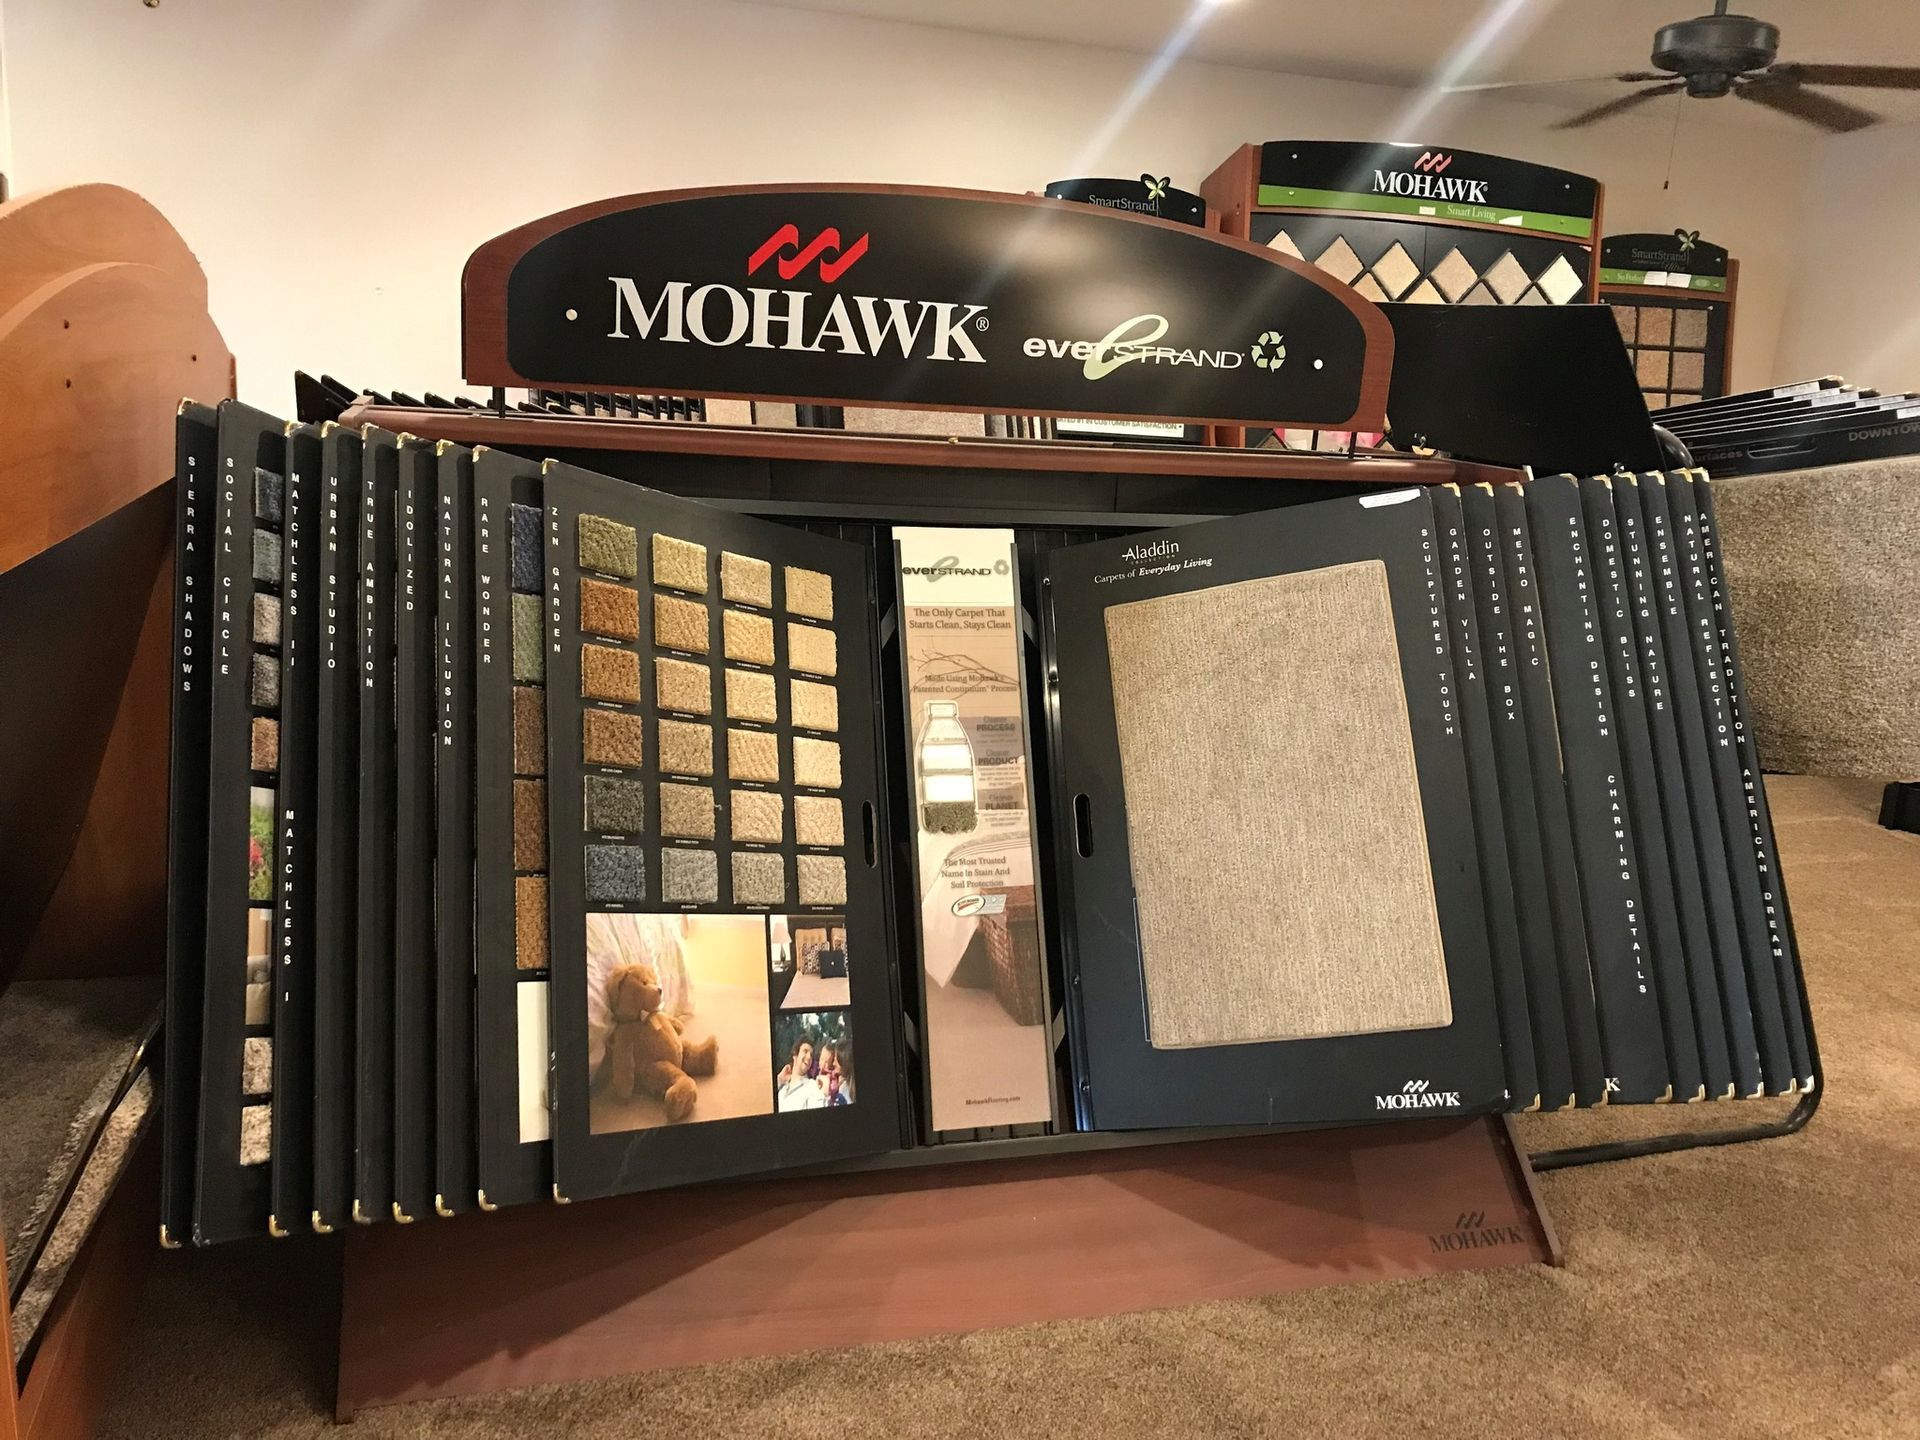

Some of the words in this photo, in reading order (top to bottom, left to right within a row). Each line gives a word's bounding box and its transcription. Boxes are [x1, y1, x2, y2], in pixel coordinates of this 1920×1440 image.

[1089, 194, 1157, 212] SmartStrand
[1372, 169, 1488, 203] MOHAWK
[1447, 205, 1471, 217] Smart
[1472, 207, 1496, 222] Living
[185, 456, 196, 551] SIERRA
[225, 457, 234, 553] SOCIAL
[290, 472, 300, 616] MATCHLESS
[329, 476, 338, 552] URBAN
[366, 481, 374, 539] TRUE
[406, 490, 414, 611] IDOLIZED
[444, 495, 452, 600] NATURAL
[481, 497, 489, 554] RARE
[551, 507, 559, 546] ZEN
[1094, 571, 1126, 584] Carpets
[1127, 569, 1137, 579] of
[1139, 562, 1181, 577] Everyday
[1183, 557, 1213, 569] Living
[1122, 540, 1180, 562] Aladdin
[1513, 527, 1529, 588] METRO
[1523, 605, 1540, 666] MAGIC
[1655, 516, 1678, 616] ENSEMBLE
[183, 576, 193, 692] SHADOWS
[221, 577, 231, 675] CIRCLE
[327, 575, 336, 669] STUDIO
[366, 562, 374, 688] AMBITION
[481, 575, 491, 663] WONDER
[552, 567, 561, 654] GARDEN
[909, 620, 934, 629] Starts
[935, 620, 963, 630] Clean,
[963, 620, 986, 631] Stays
[986, 620, 1011, 629] Clean
[913, 607, 930, 617] The
[931, 608, 954, 619] Only
[955, 608, 984, 619] Carpet
[985, 608, 1006, 617] That
[1421, 528, 1444, 655] SCULPTURED
[1439, 672, 1454, 735] TOUCH
[1450, 528, 1466, 601] GARDEN
[1461, 619, 1477, 681] VILLA
[1483, 528, 1501, 615] OUTSIDE
[1497, 632, 1508, 667] THE
[1504, 685, 1515, 721] BOX
[1569, 516, 1595, 643] ENCHANTING
[1590, 661, 1609, 737] DESIGN
[1602, 518, 1624, 618] DOMESTIC
[1620, 636, 1636, 698] BLISS
[1627, 518, 1650, 618] STUNNING
[1645, 635, 1664, 711] NATURE
[1684, 514, 1704, 600] NATURAL
[1701, 618, 1729, 747] REFLECTION
[1700, 513, 1723, 611] AMERICAN
[1719, 628, 1745, 744] TRADITION
[444, 622, 452, 746] ILLUSION
[976, 723, 1016, 731] PROCESS
[990, 684, 1017, 692] Process
[978, 757, 1019, 765] PRODUCT
[985, 802, 1019, 810] PLANET
[284, 810, 295, 965] MATCHLESS
[941, 870, 964, 878] Name
[965, 869, 973, 877] In
[973, 869, 993, 877] Stain
[995, 867, 1011, 876] And
[944, 858, 958, 867] The
[959, 858, 977, 866] Most
[978, 856, 1007, 865] Trusted
[950, 880, 965, 889] Soil
[966, 880, 1004, 888] Protection
[1607, 775, 1630, 880] CHARMING
[1626, 899, 1647, 994] DETAILS
[1743, 768, 1768, 873] AMERICAN
[1764, 892, 1783, 957] DREAM
[1375, 1092, 1461, 1110] MOHAWK
[1428, 1226, 1525, 1253] MOHAWK
